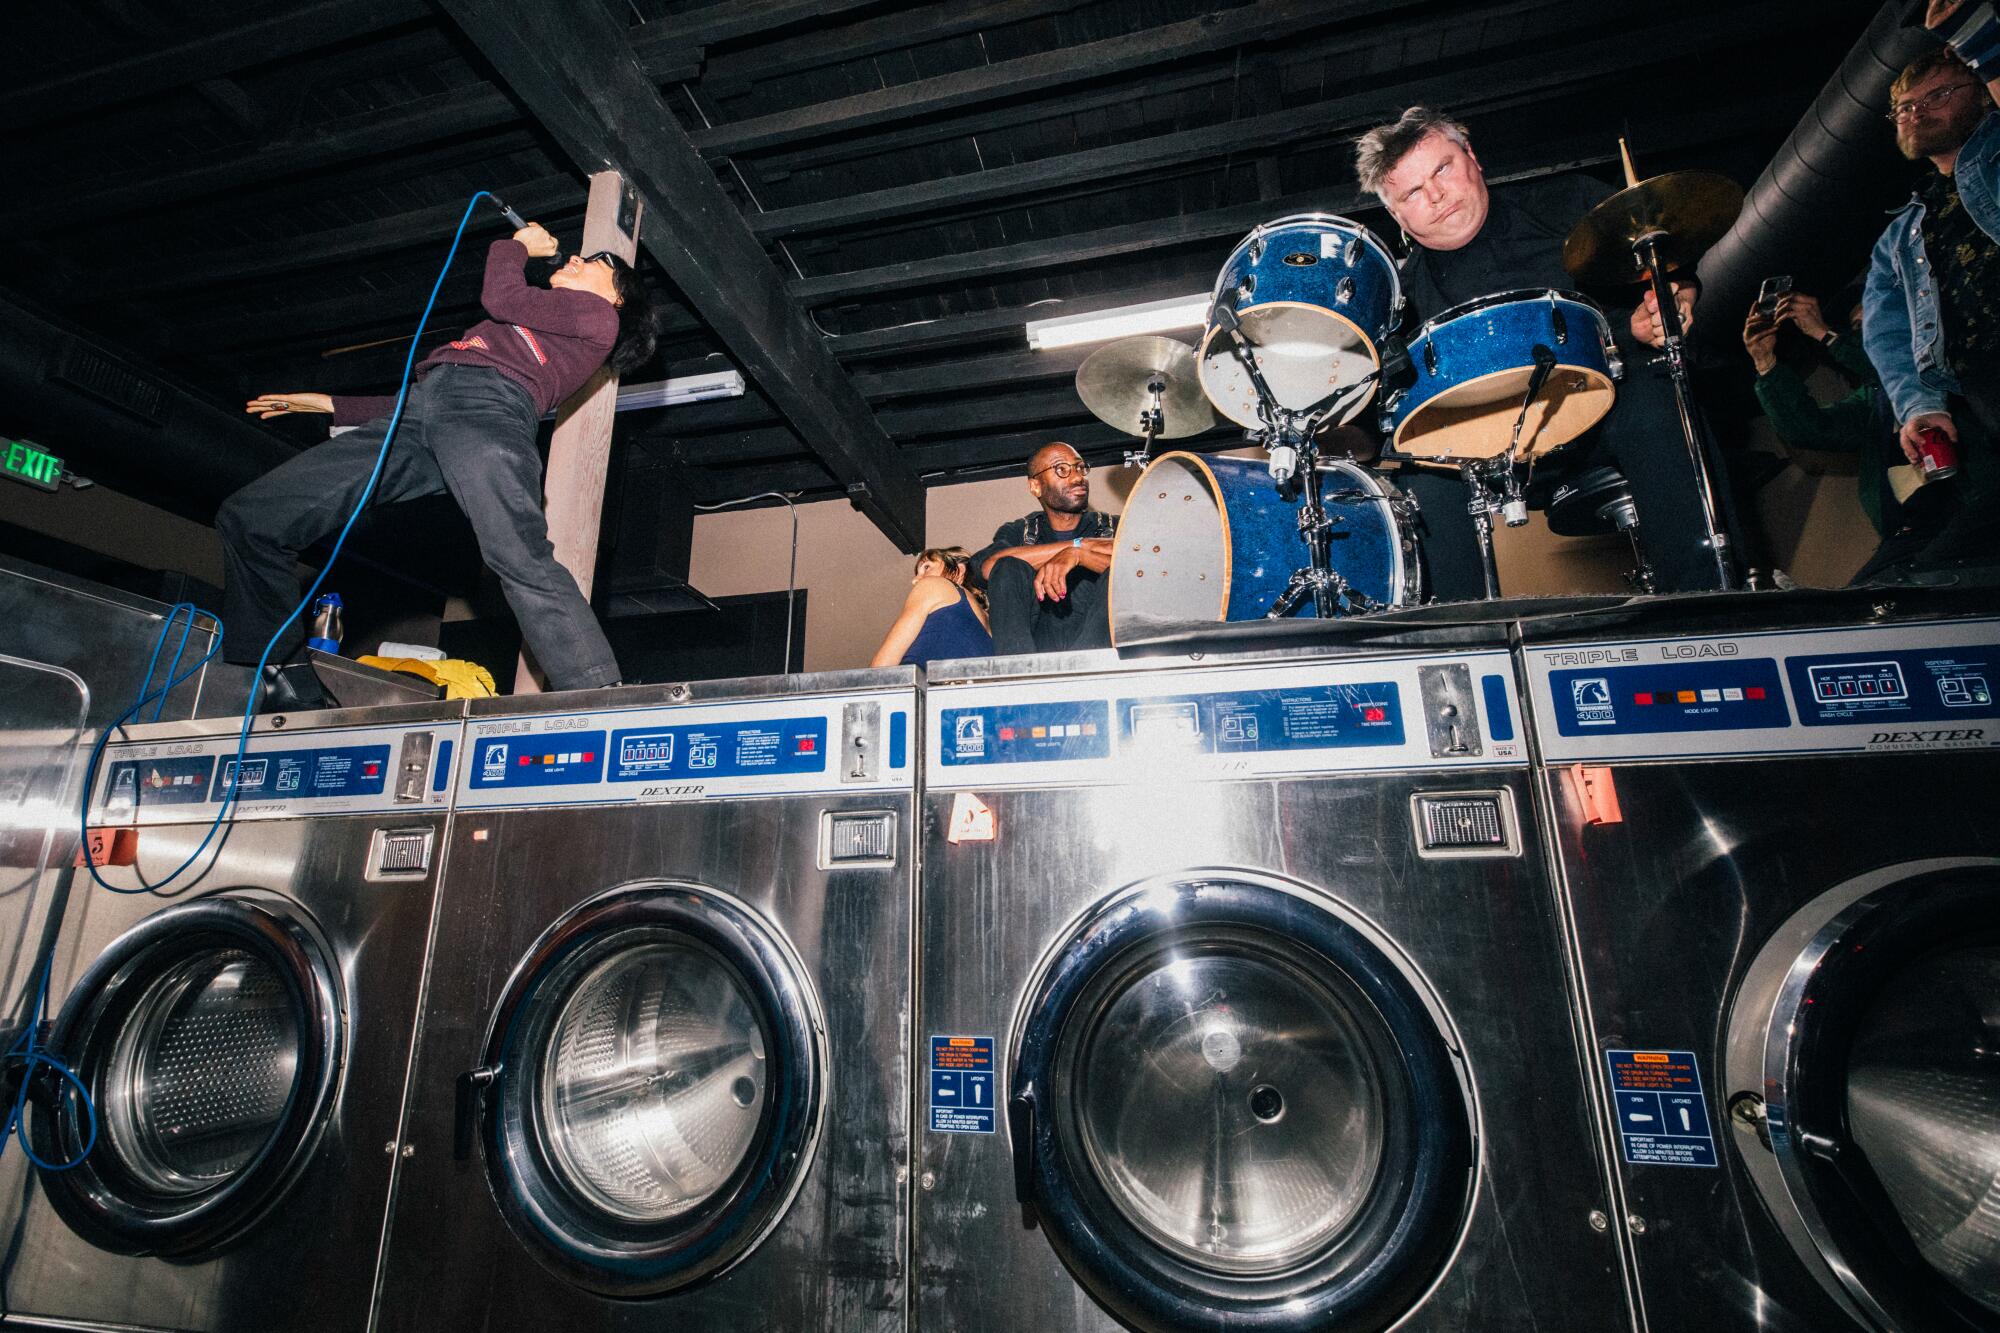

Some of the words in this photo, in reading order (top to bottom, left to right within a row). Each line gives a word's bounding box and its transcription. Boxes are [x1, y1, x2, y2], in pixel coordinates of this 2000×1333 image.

[6, 442, 59, 483] EXIT
[1544, 649, 1639, 666] TRIPLE
[1662, 643, 1738, 660] LOAD
[1577, 711, 1614, 720] 400
[477, 722, 532, 734] TRIPLE
[544, 718, 589, 730] LOAD
[1868, 729, 1984, 744] DEXTER
[114, 747, 157, 758] TRIPLE
[167, 744, 203, 755] LOAD
[1869, 741, 1937, 751] COMMERCIAL
[640, 785, 704, 796] DEXTER
